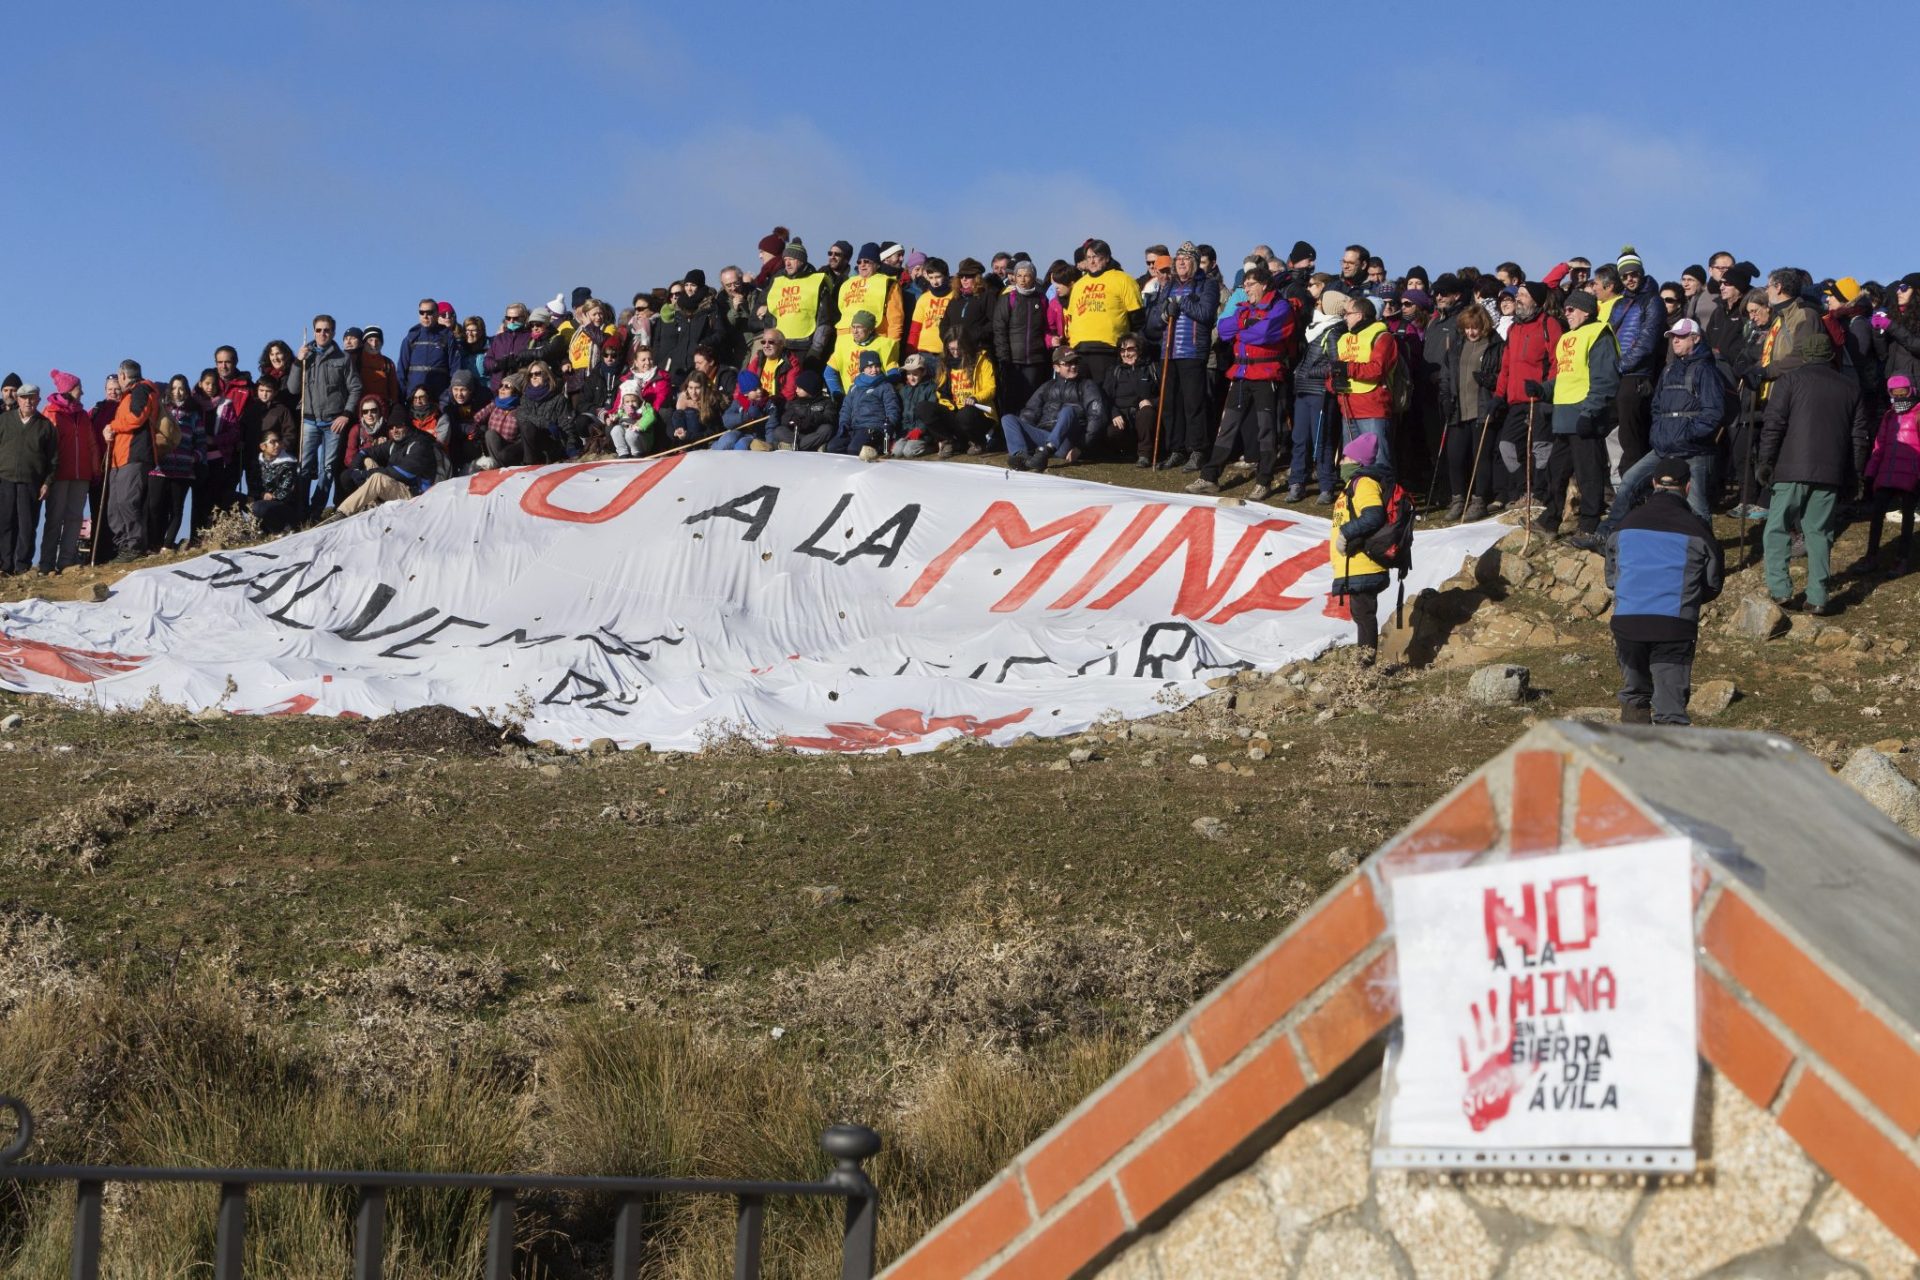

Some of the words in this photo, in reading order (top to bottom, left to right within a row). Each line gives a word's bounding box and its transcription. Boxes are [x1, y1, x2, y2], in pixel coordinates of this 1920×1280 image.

[782, 286, 800, 297] NO
[1083, 283, 1105, 294] NO
[681, 485, 780, 542] A
[793, 492, 922, 569] LA
[1484, 875, 1599, 961] NO
[1492, 945, 1508, 971] A
[1522, 941, 1557, 968] LA
[1510, 966, 1617, 1018] MINA
[1544, 1018, 1566, 1035] LA
[1511, 1033, 1612, 1064] SIERRA
[1562, 1062, 1601, 1083] DE
[1528, 1072, 1618, 1111] ÁVILA
